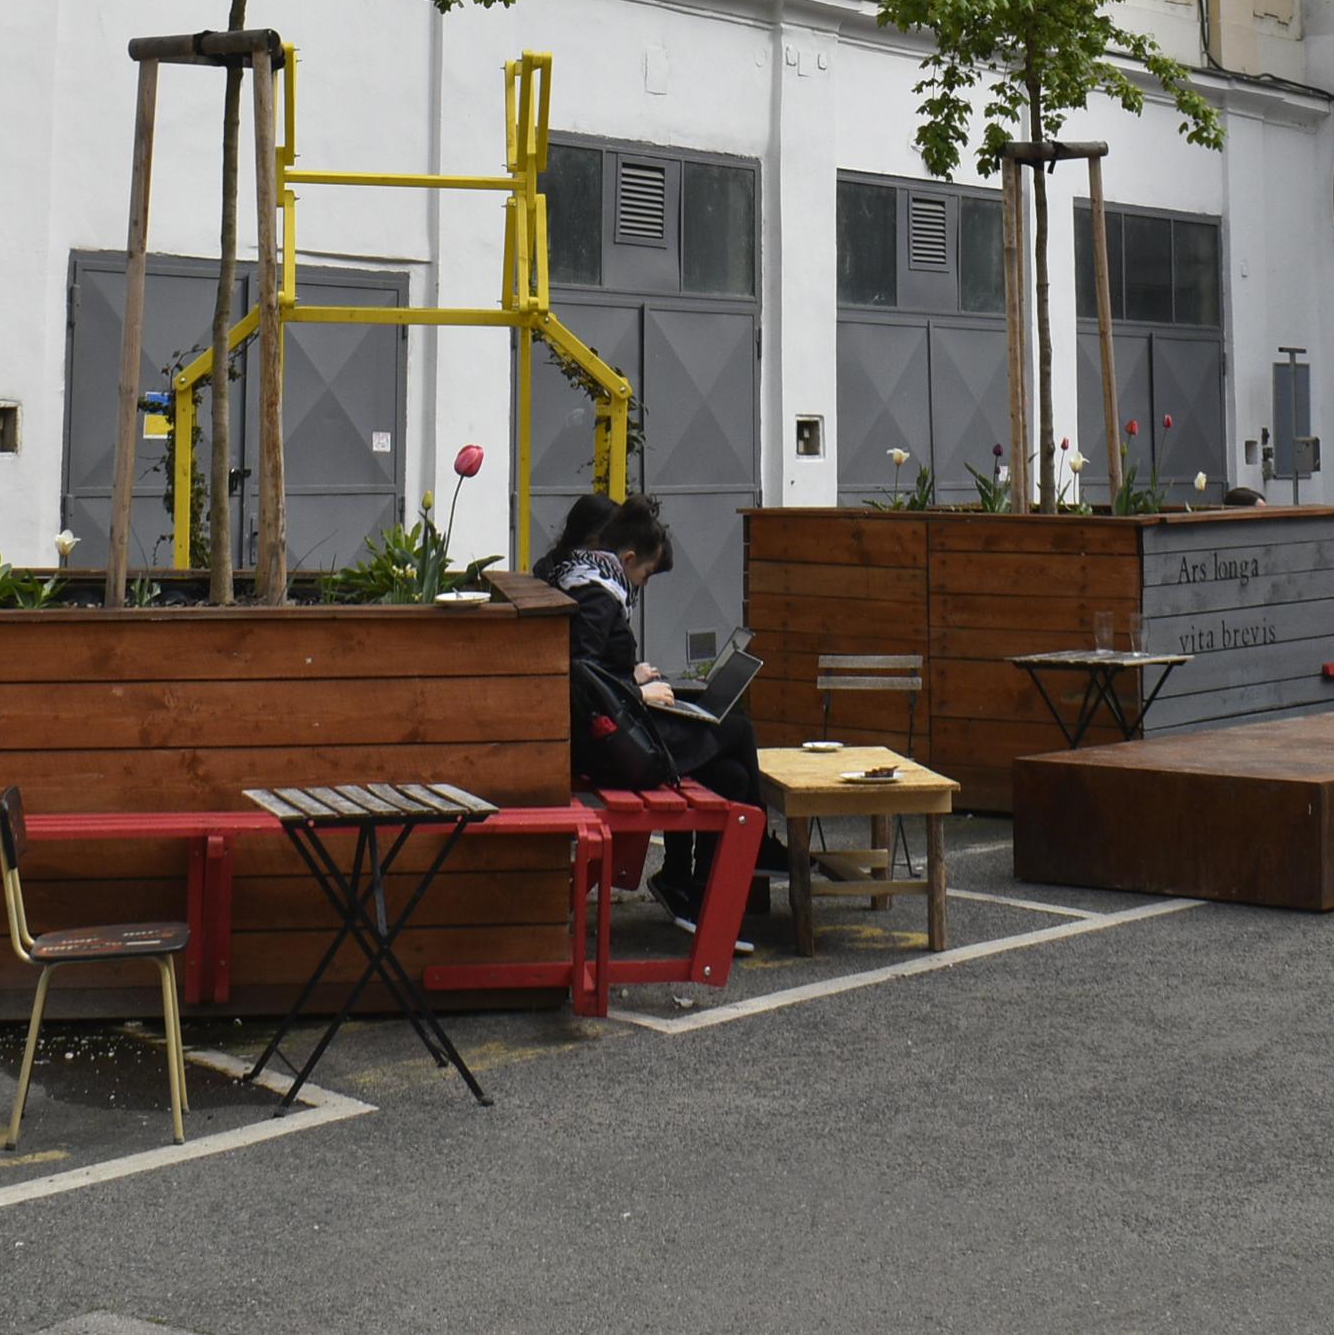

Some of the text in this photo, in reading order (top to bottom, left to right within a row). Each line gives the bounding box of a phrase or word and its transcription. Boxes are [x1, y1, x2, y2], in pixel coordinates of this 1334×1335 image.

[1178, 552, 1260, 588] Ars longa
[1179, 618, 1276, 654] vita brevis
